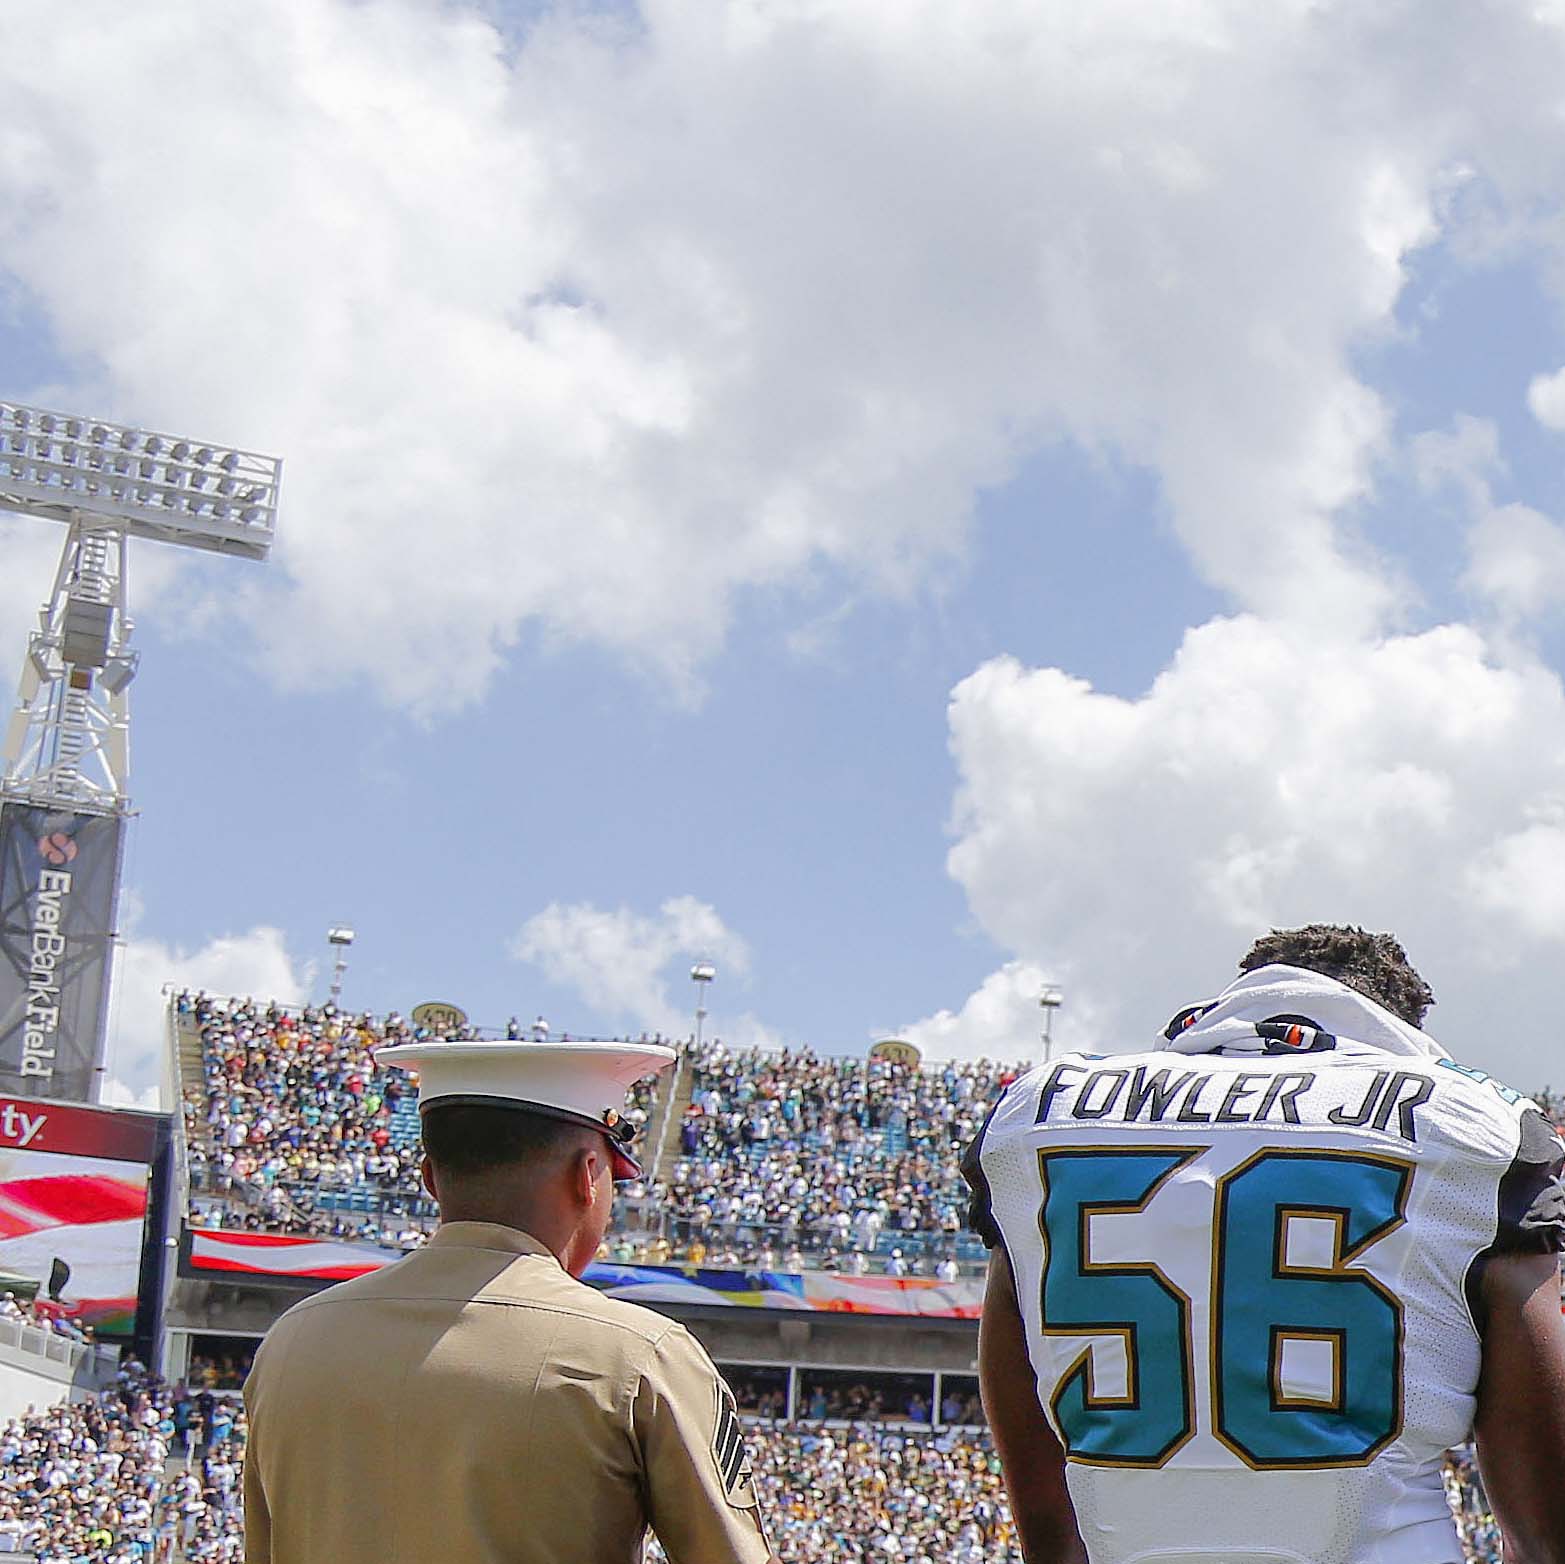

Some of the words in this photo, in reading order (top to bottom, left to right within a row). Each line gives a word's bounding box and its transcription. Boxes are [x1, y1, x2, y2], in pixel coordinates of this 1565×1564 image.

[28, 869, 71, 1006] EverBank
[21, 1003, 58, 1079] Field
[1034, 1064, 1316, 1124] FOWLER
[1328, 1071, 1436, 1143] JR
[1037, 1146, 1416, 1471] 56
